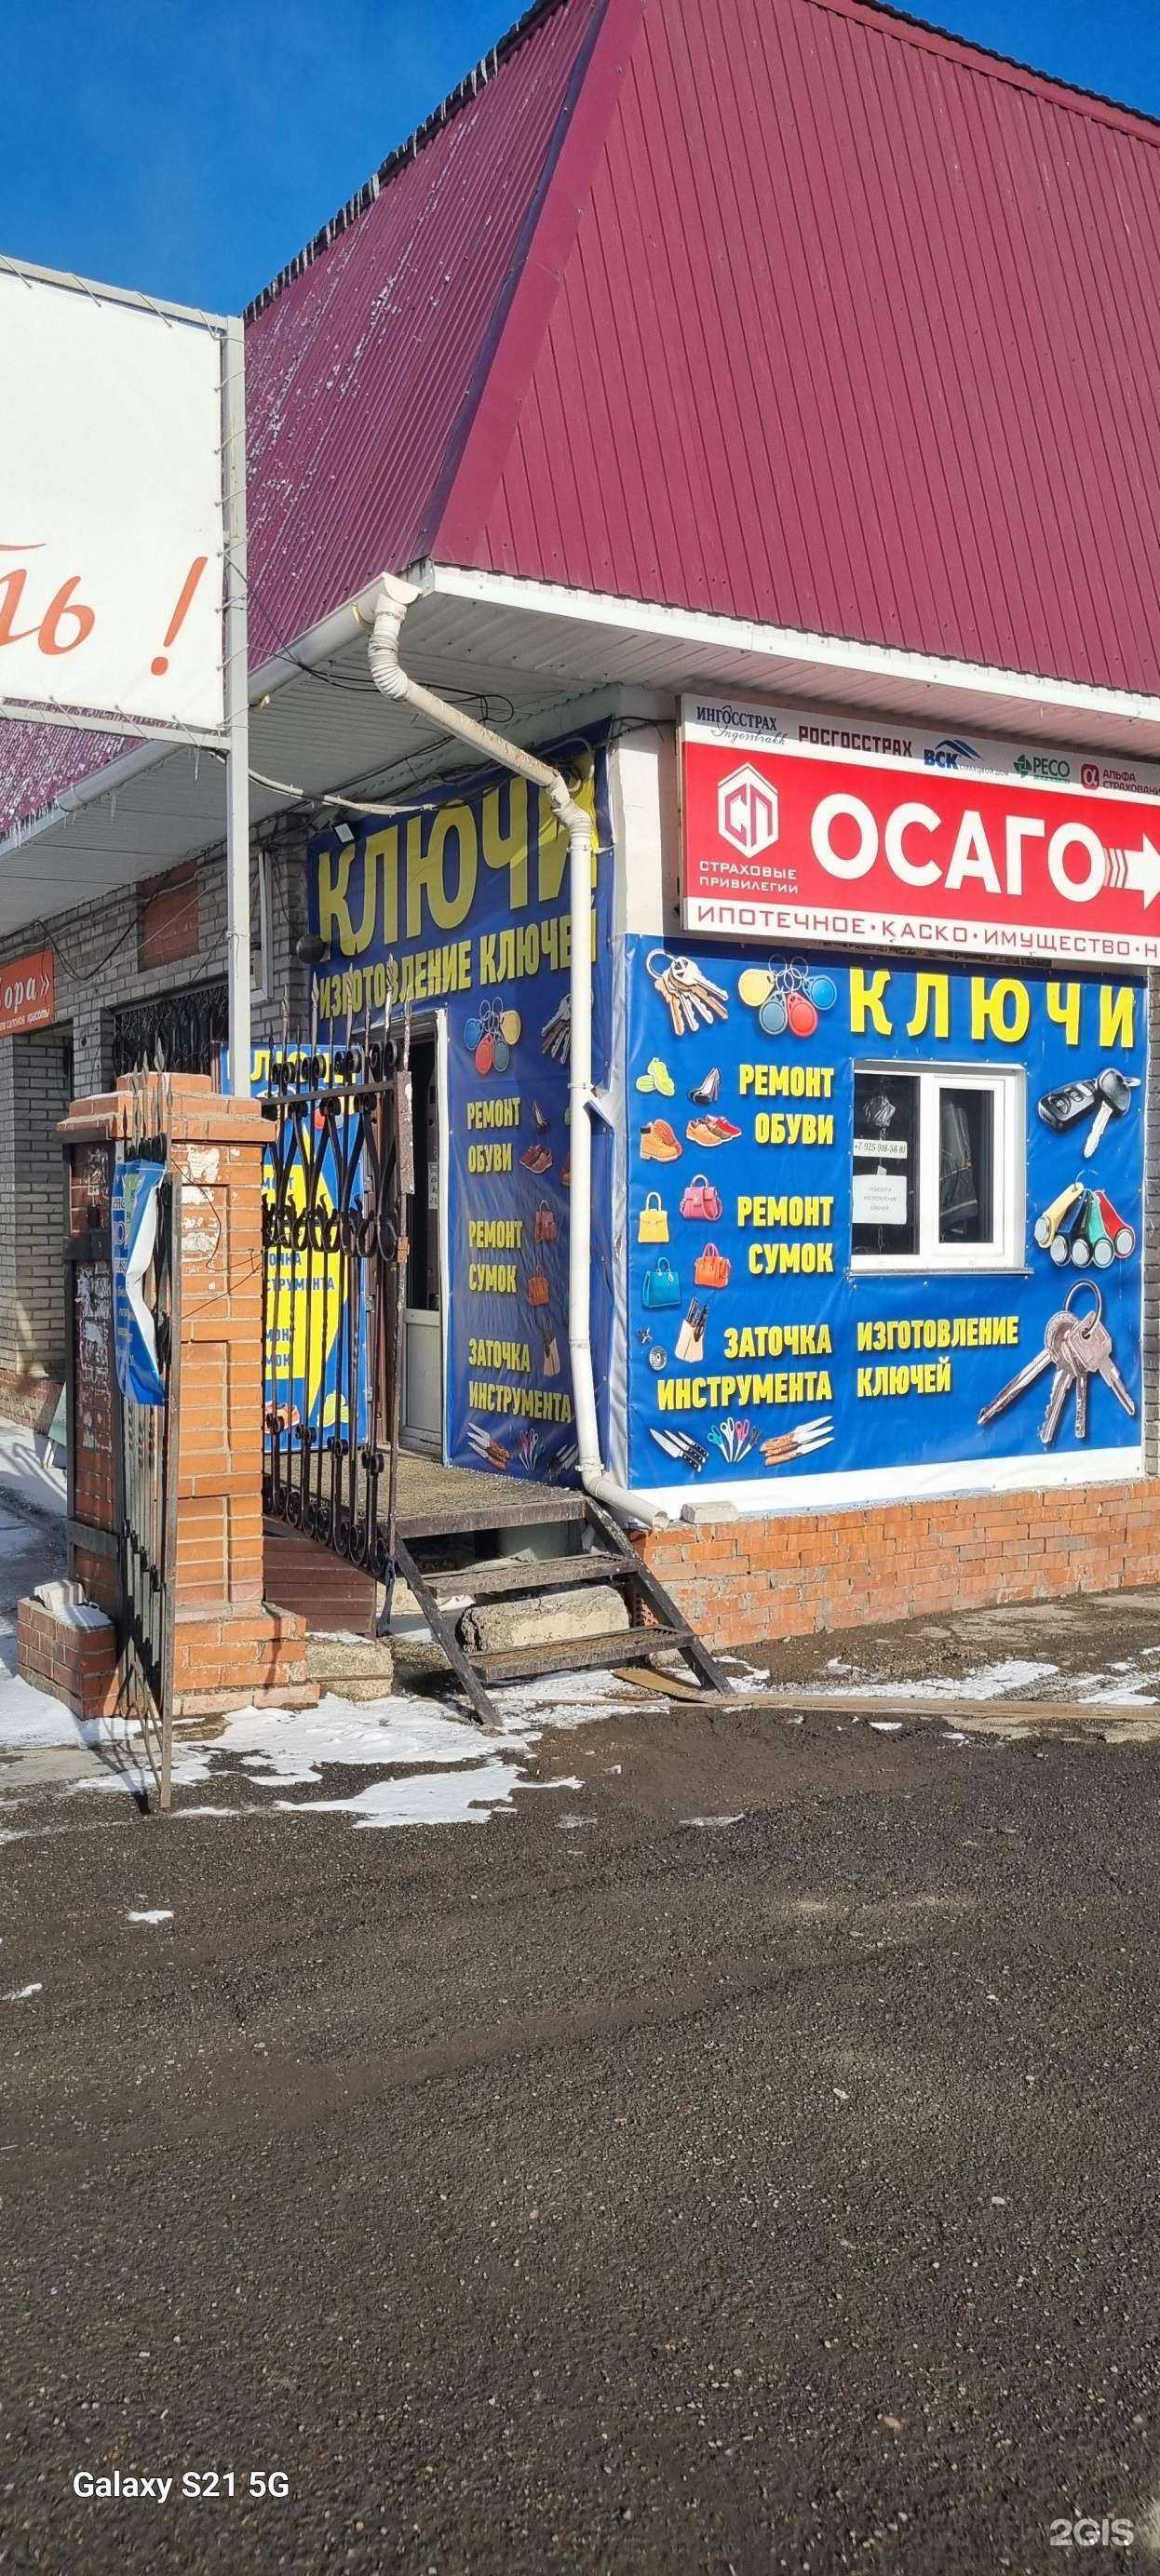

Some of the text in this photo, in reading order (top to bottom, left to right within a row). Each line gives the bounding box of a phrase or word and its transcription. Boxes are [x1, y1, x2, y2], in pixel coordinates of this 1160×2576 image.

[696, 704, 777, 731] ИНГОССТРАХ
[799, 725, 912, 758] РОСГОССТРАХ
[924, 748, 960, 770] ВСК
[1033, 757, 1071, 778] РЕСО
[1102, 769, 1137, 783] АЛЬФА
[318, 755, 598, 957] КЛЮЧИ
[811, 793, 1108, 904] ОСАГО
[699, 860, 797, 881] СТРАХОВЫЕ
[699, 877, 799, 895] ПРИВИЛЕГИИ
[697, 905, 866, 934] ИПОТЕЧНОЕ
[882, 921, 968, 945] КАСКО
[983, 928, 1131, 958] ИМУЩЕСТВО
[0, 972, 51, 1014] ора»
[319, 940, 473, 1020] ИЗГОТОВЛЕНИЕ
[848, 967, 1136, 1049] КЛЮЧИ
[739, 1064, 835, 1098] РЕМОНТ
[467, 1096, 521, 1131] РЕМОНТ
[754, 1112, 835, 1146] ОБУВИ
[467, 1143, 513, 1174] ОБУВИ
[737, 1196, 834, 1228] РЕМОНТ
[468, 1219, 523, 1250] РЕМОНТ
[749, 1242, 834, 1275] СУМОК
[468, 1263, 518, 1294] СУМОК
[723, 1324, 833, 1361] ЗАТОЧКА
[857, 1315, 1019, 1352] ИЗГОТОВЛЕНИЕ
[468, 1337, 532, 1373] ЗАТОЧКА
[656, 1370, 833, 1412] ИНСТРУМЕНТА
[857, 1356, 951, 1398] КЛЮЧЕЙ
[468, 1380, 573, 1425] ИНСТРУМЕНТА
